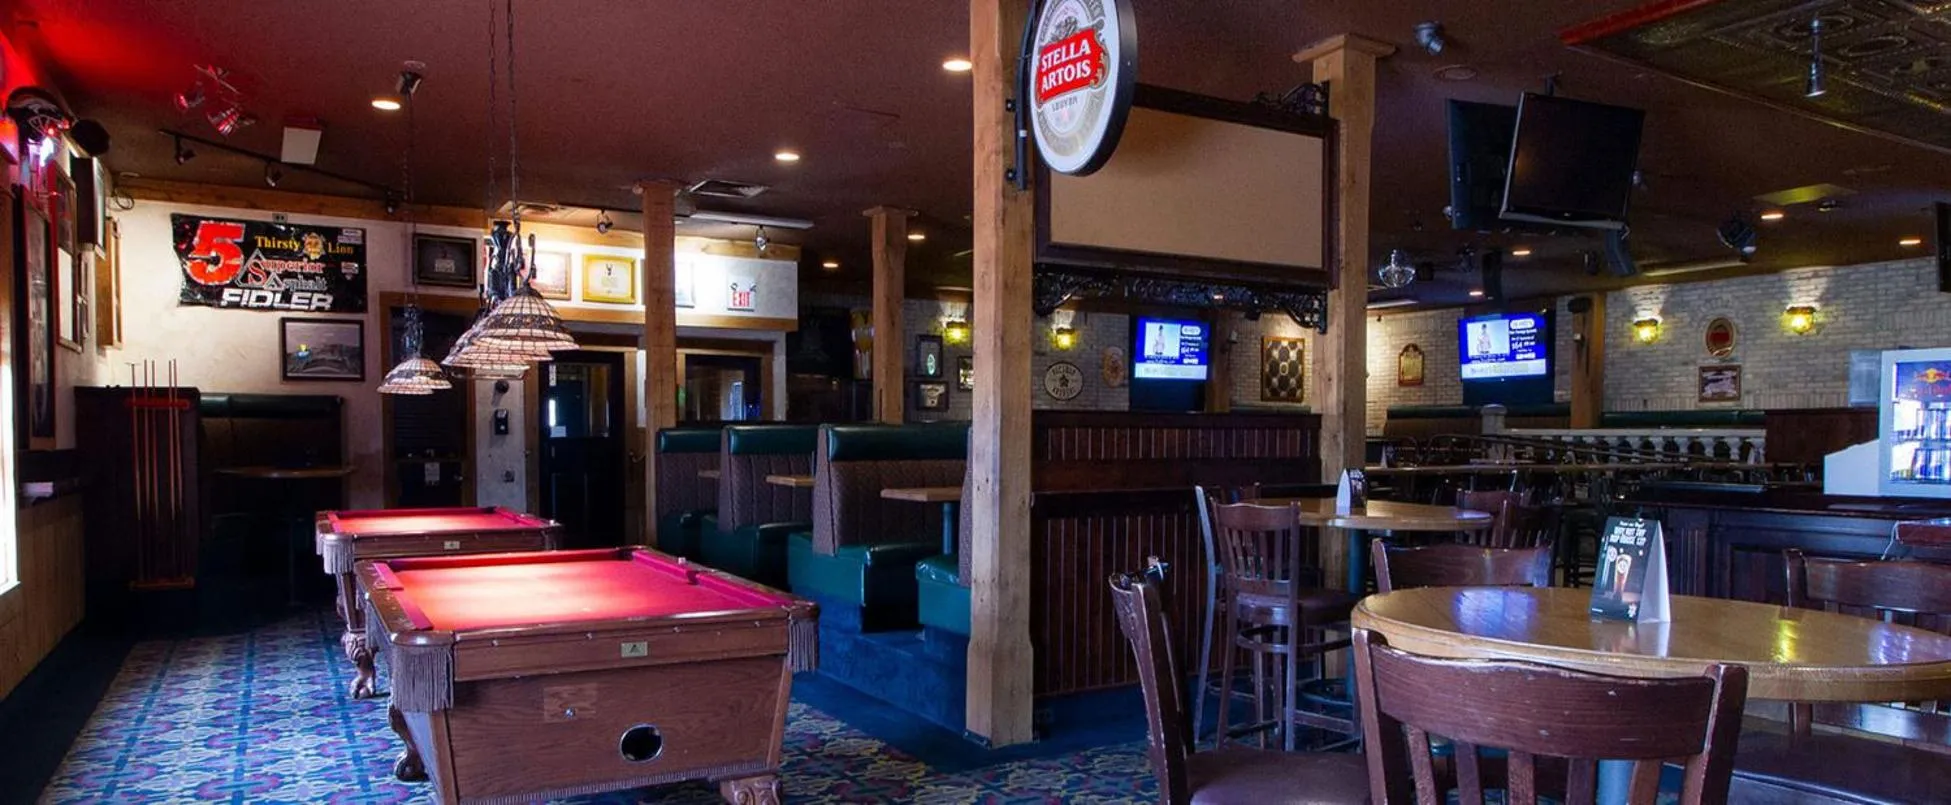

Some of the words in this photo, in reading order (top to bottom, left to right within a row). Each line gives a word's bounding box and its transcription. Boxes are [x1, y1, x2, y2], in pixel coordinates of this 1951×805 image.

[1041, 39, 1091, 72] STELLA
[1041, 60, 1091, 93] ARTOIS
[183, 220, 245, 284] 5
[255, 235, 300, 251] Thirsty
[328, 242, 354, 254] Lion
[249, 257, 325, 284] Superior
[264, 273, 328, 291] Asphalt
[221, 288, 333, 310] FIDLER
[733, 291, 750, 307] EXIT
